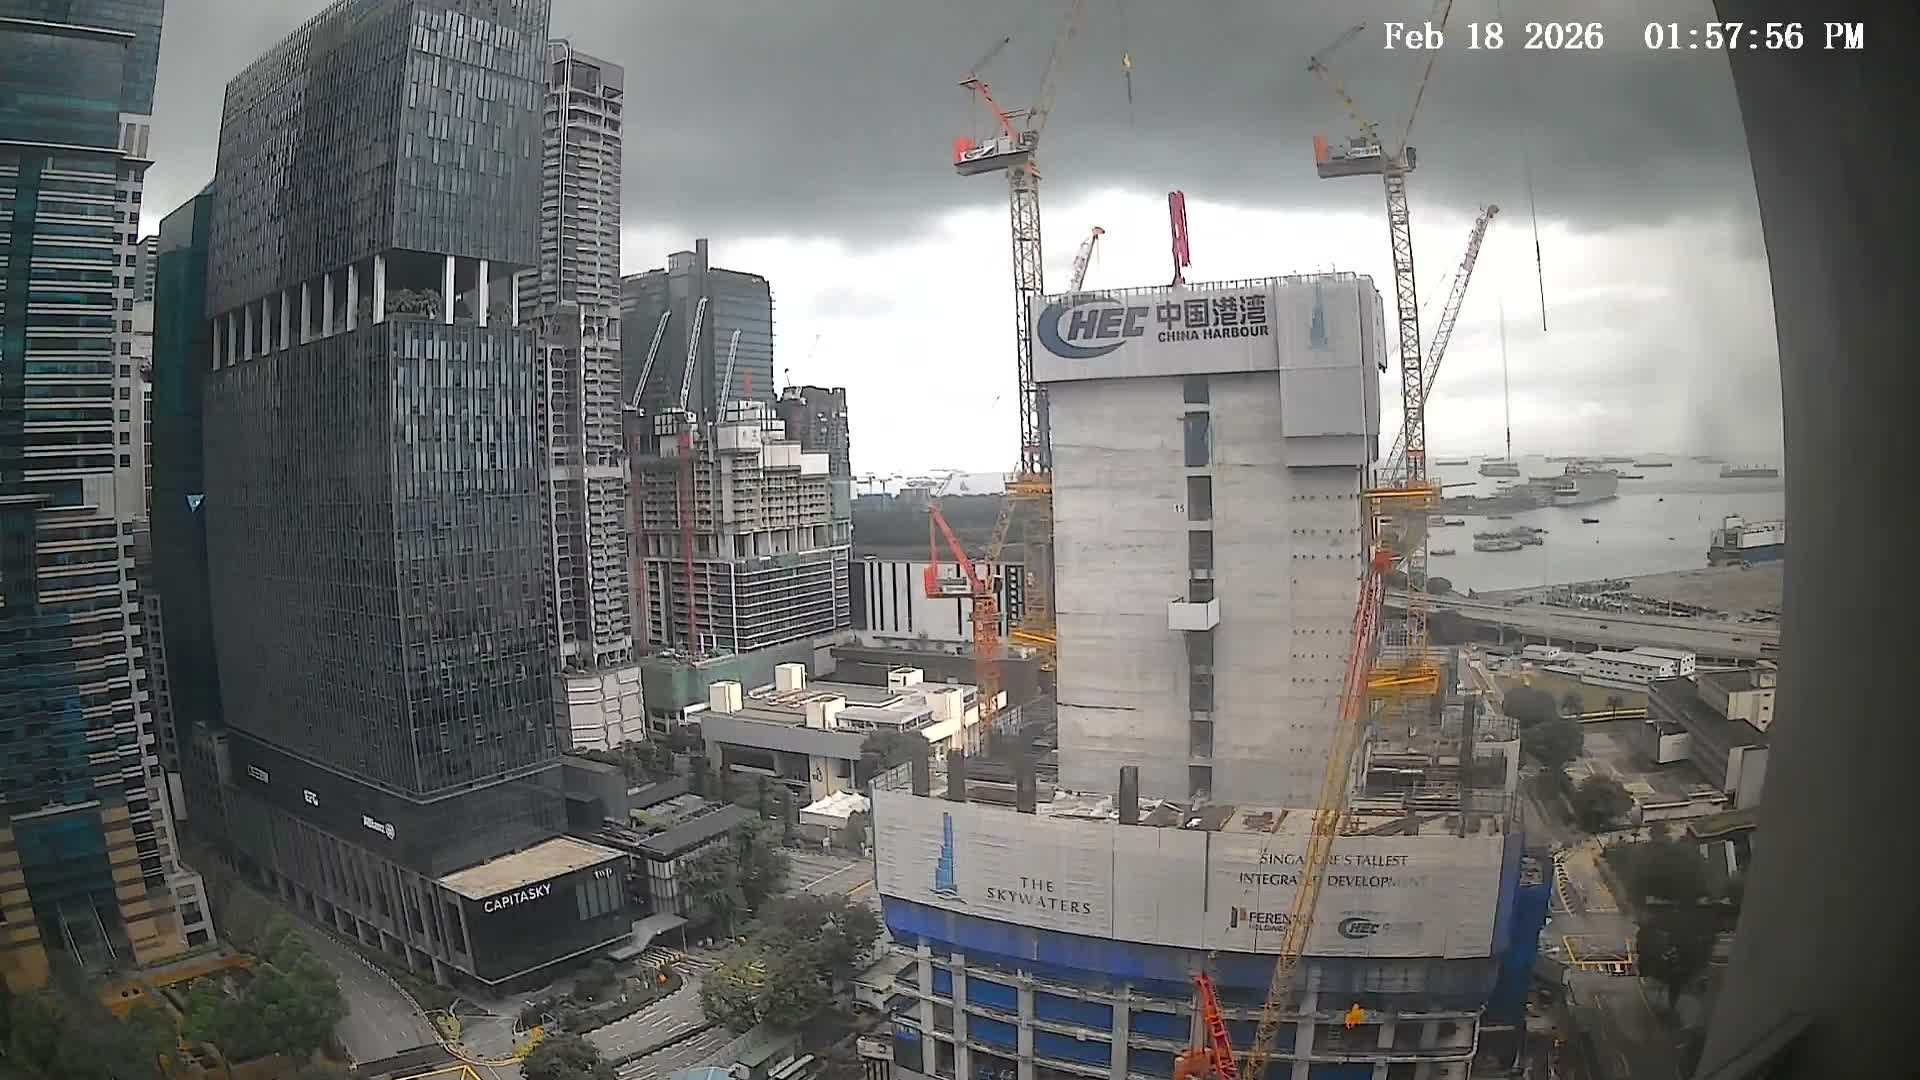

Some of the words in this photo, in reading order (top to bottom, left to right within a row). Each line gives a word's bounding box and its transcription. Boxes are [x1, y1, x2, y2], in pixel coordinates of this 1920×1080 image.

[1155, 294, 1267, 331] 中国港湾
[1157, 329, 1200, 344] CHINA
[1202, 324, 1270, 341] HARBOUR
[1356, 854, 1409, 868] TALLEST
[1019, 876, 1054, 893] THE
[1239, 871, 1322, 886] INTEGRA
[484, 882, 552, 913] CAPITASKY
[987, 887, 1092, 915] SKYWATERS
